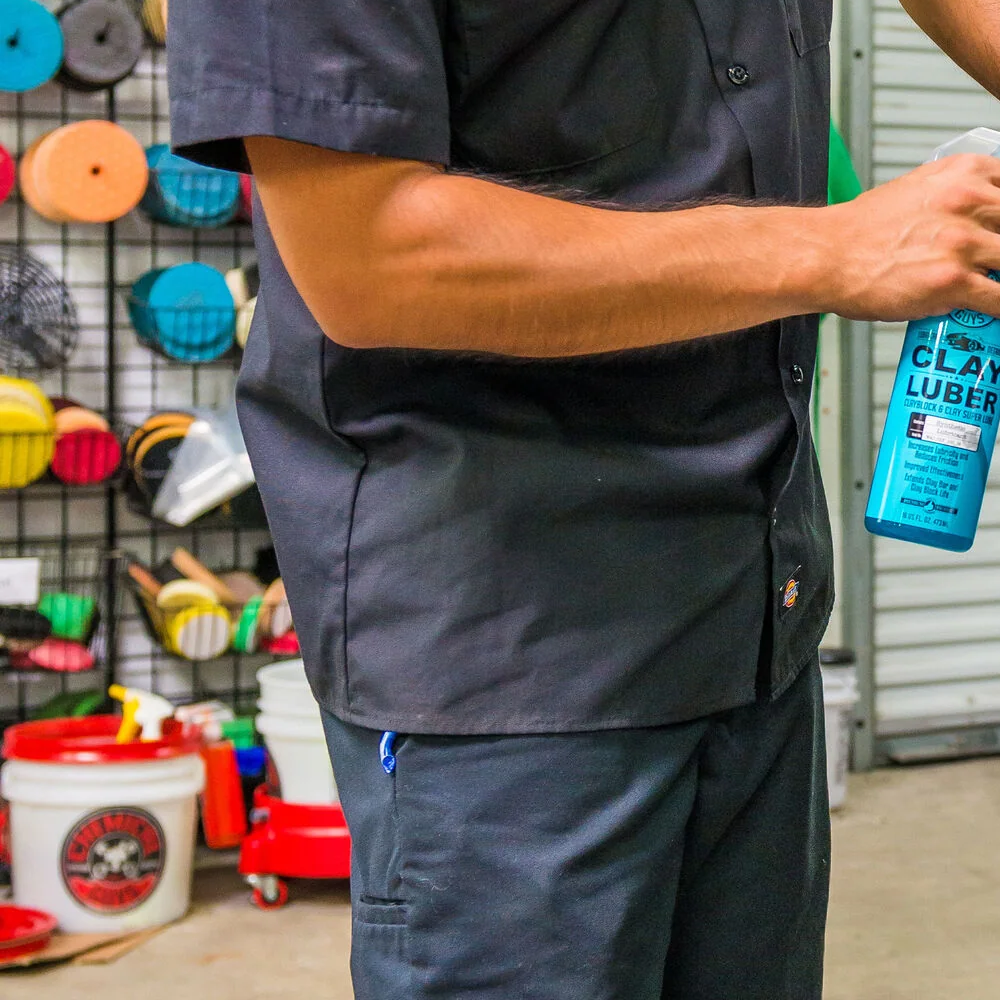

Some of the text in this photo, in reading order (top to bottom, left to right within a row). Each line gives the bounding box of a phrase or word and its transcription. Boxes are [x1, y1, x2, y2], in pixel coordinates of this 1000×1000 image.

[955, 309, 986, 325] GUYS
[906, 375, 998, 415] LUBER
[945, 407, 962, 418] CLAY
